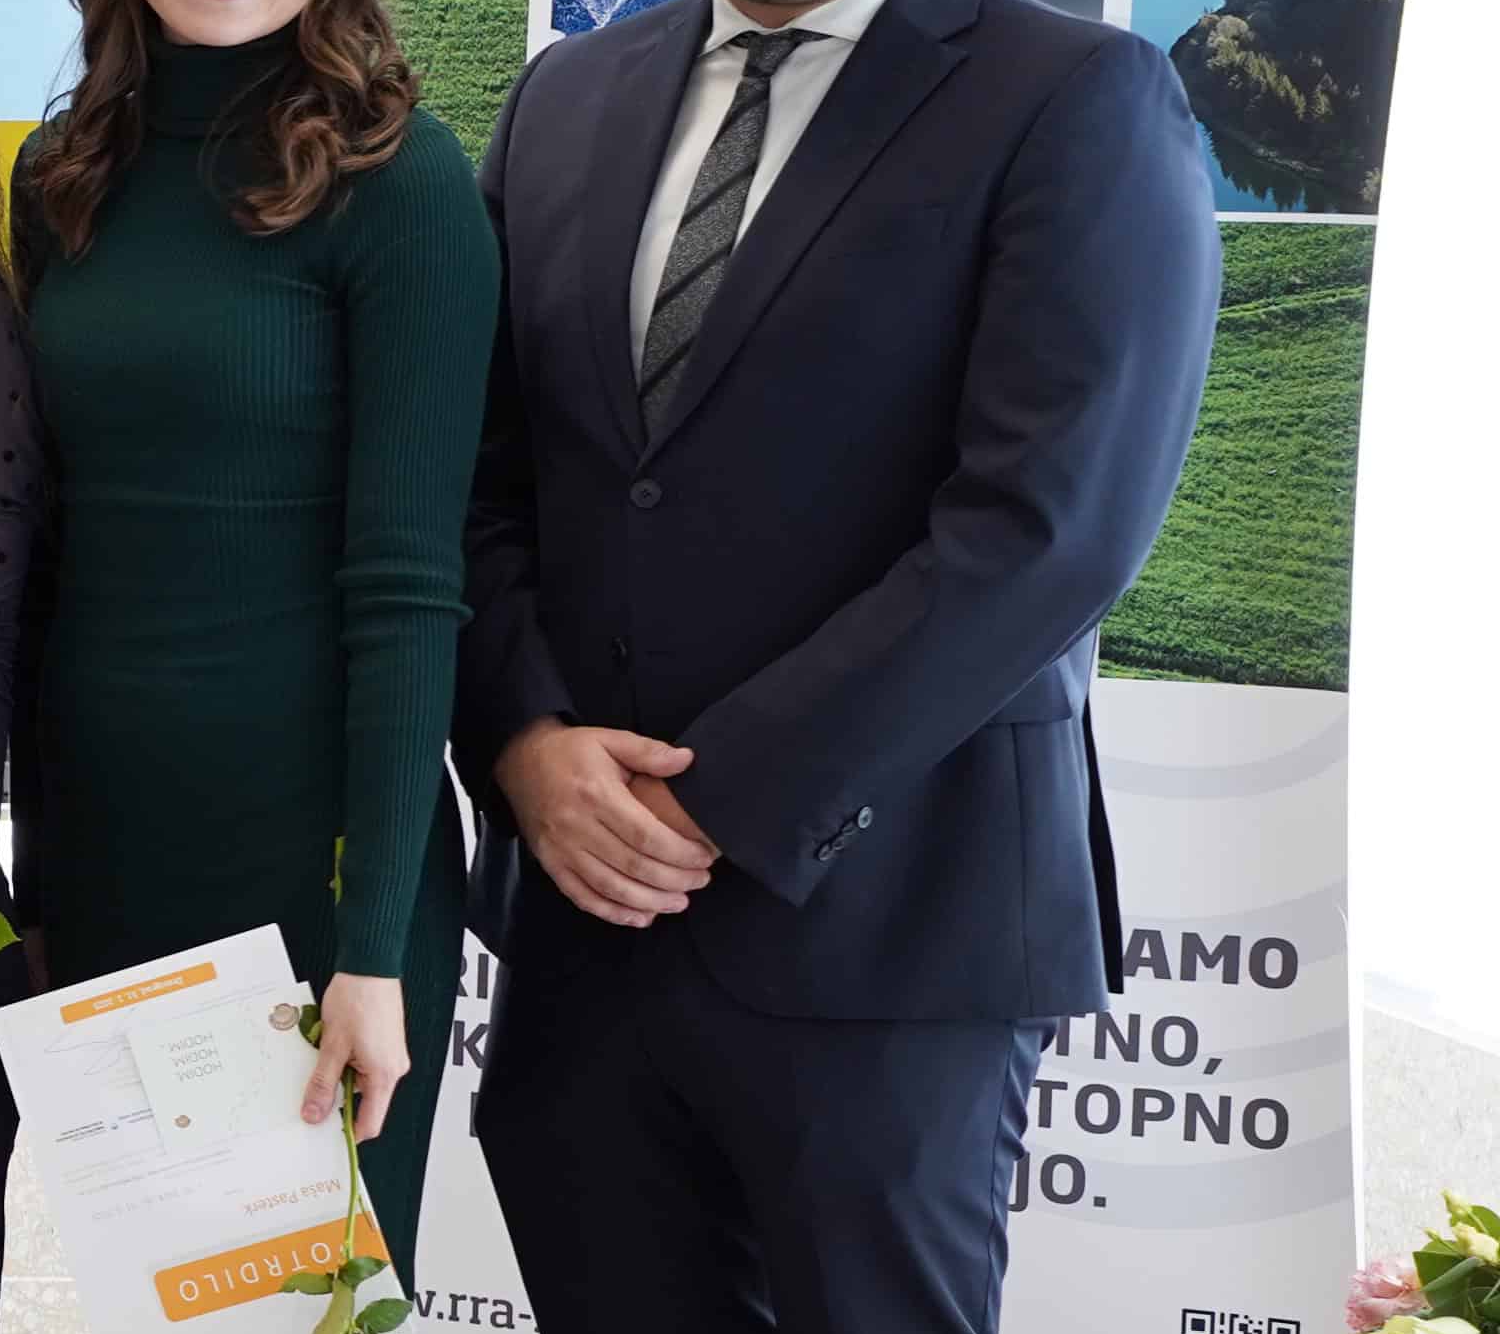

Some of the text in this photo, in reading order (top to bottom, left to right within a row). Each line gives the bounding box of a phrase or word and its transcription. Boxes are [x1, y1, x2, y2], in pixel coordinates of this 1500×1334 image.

[1123, 928, 1299, 989] AMO
[1032, 1079, 1289, 1150] TOPNO
[1008, 1153, 1107, 1212] JO.
[179, 1242, 342, 1301] OTRDILO
